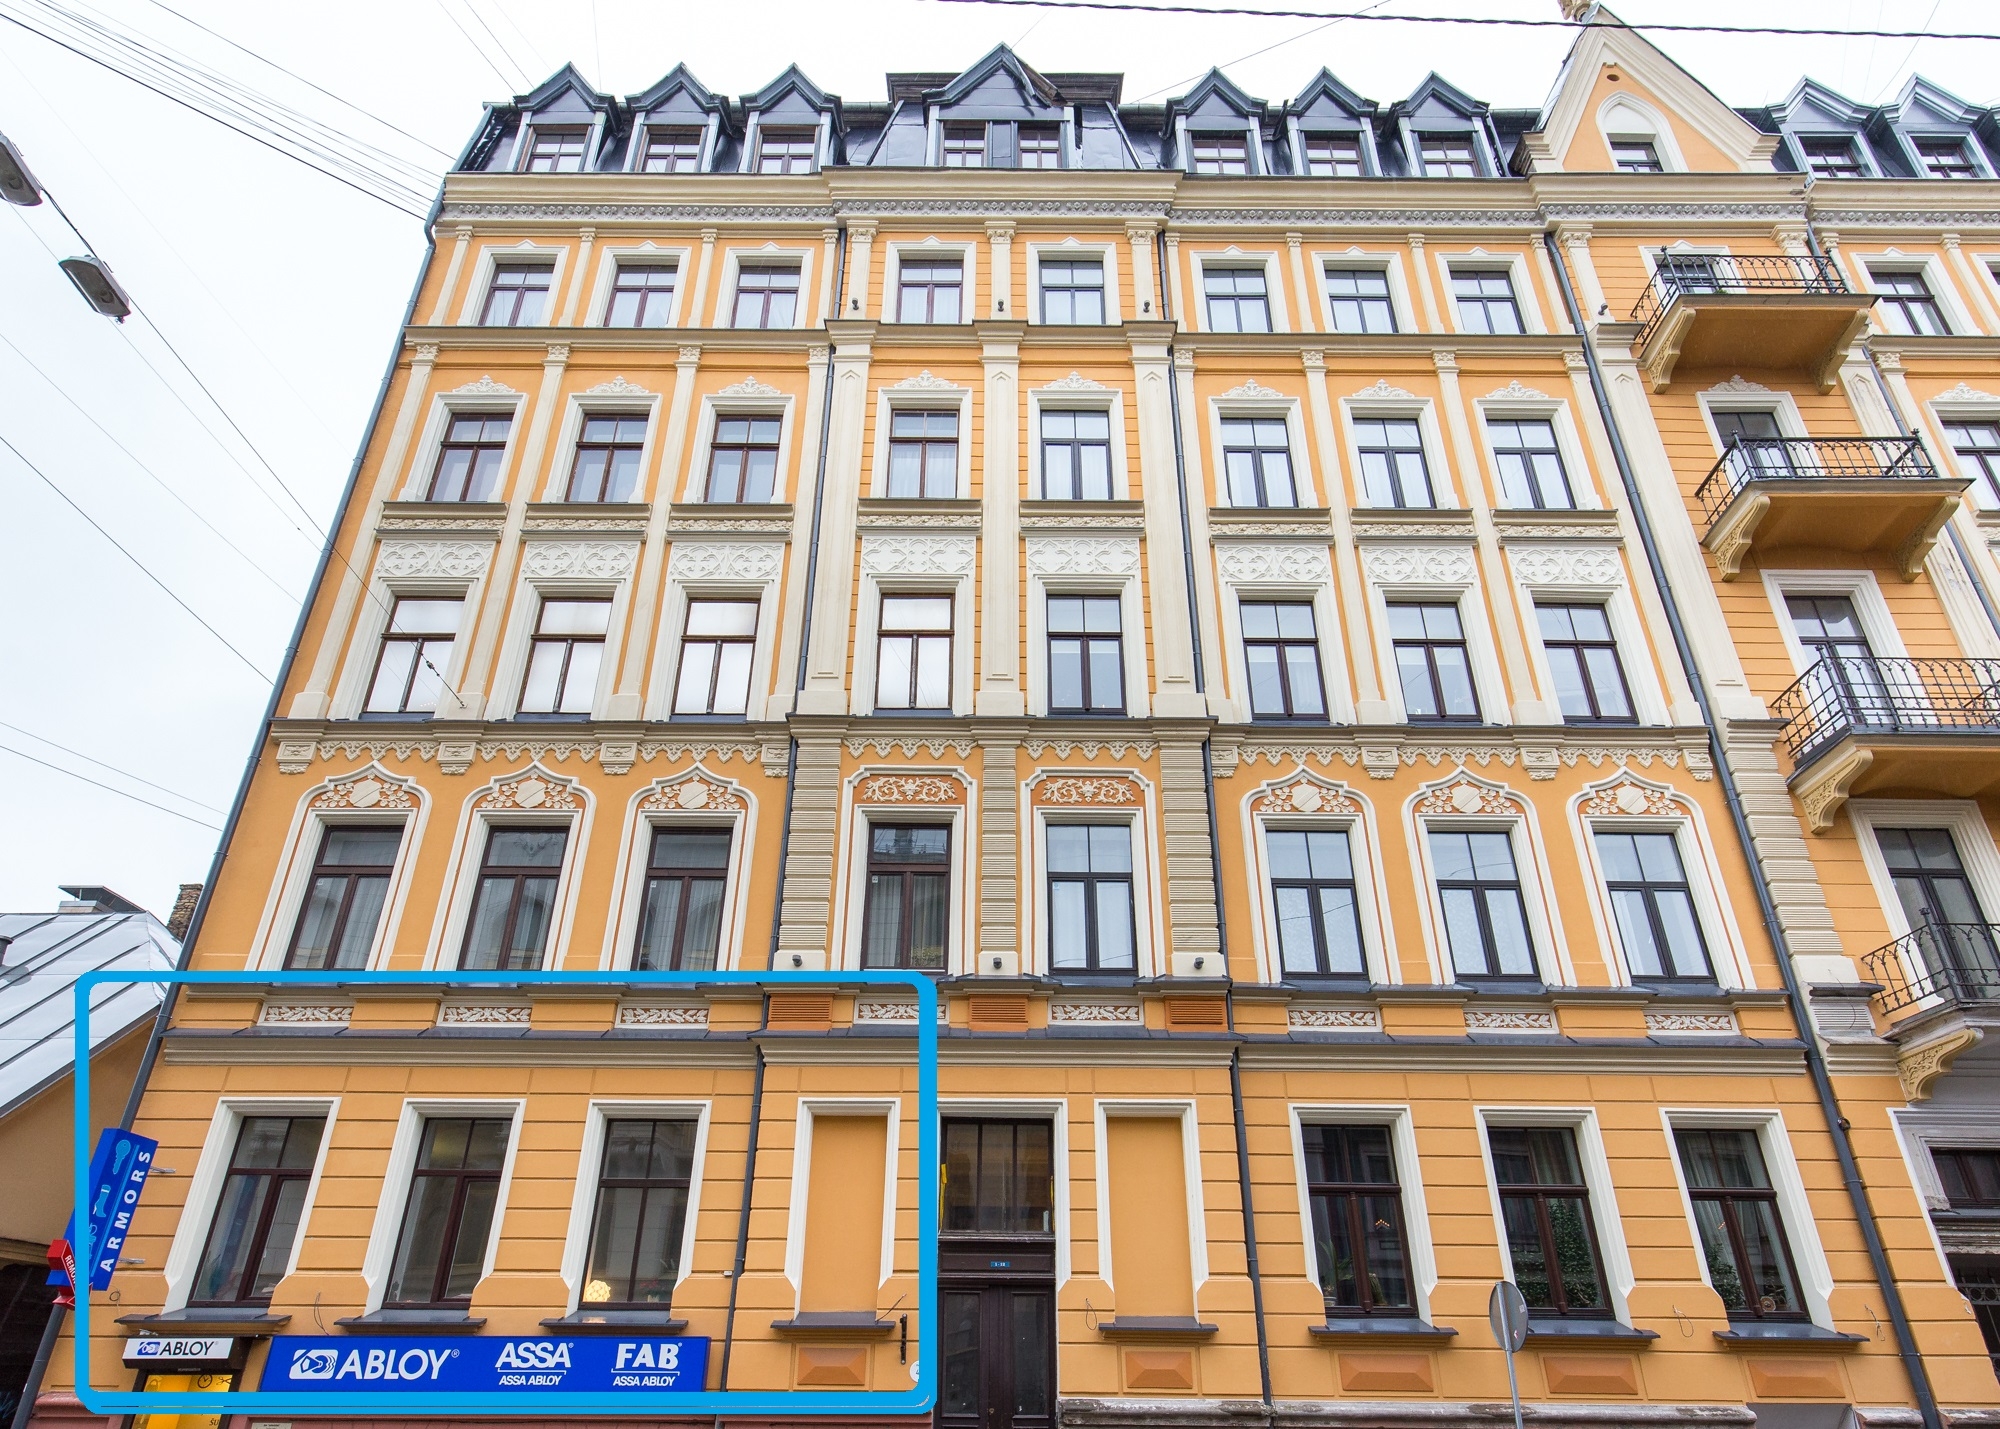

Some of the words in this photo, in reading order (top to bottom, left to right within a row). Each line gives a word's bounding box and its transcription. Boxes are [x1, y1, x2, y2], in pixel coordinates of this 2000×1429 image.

[100, 1151, 151, 1272] ARMORS
[159, 1341, 214, 1356] ABLOY
[495, 1342, 571, 1368] ASSA
[615, 1343, 680, 1370] FAB
[335, 1348, 451, 1380] ABLOY
[499, 1375, 526, 1386] ASSA
[527, 1375, 562, 1386] ABLOY
[613, 1376, 640, 1387] ASSA
[641, 1376, 676, 1387] ABLOY
